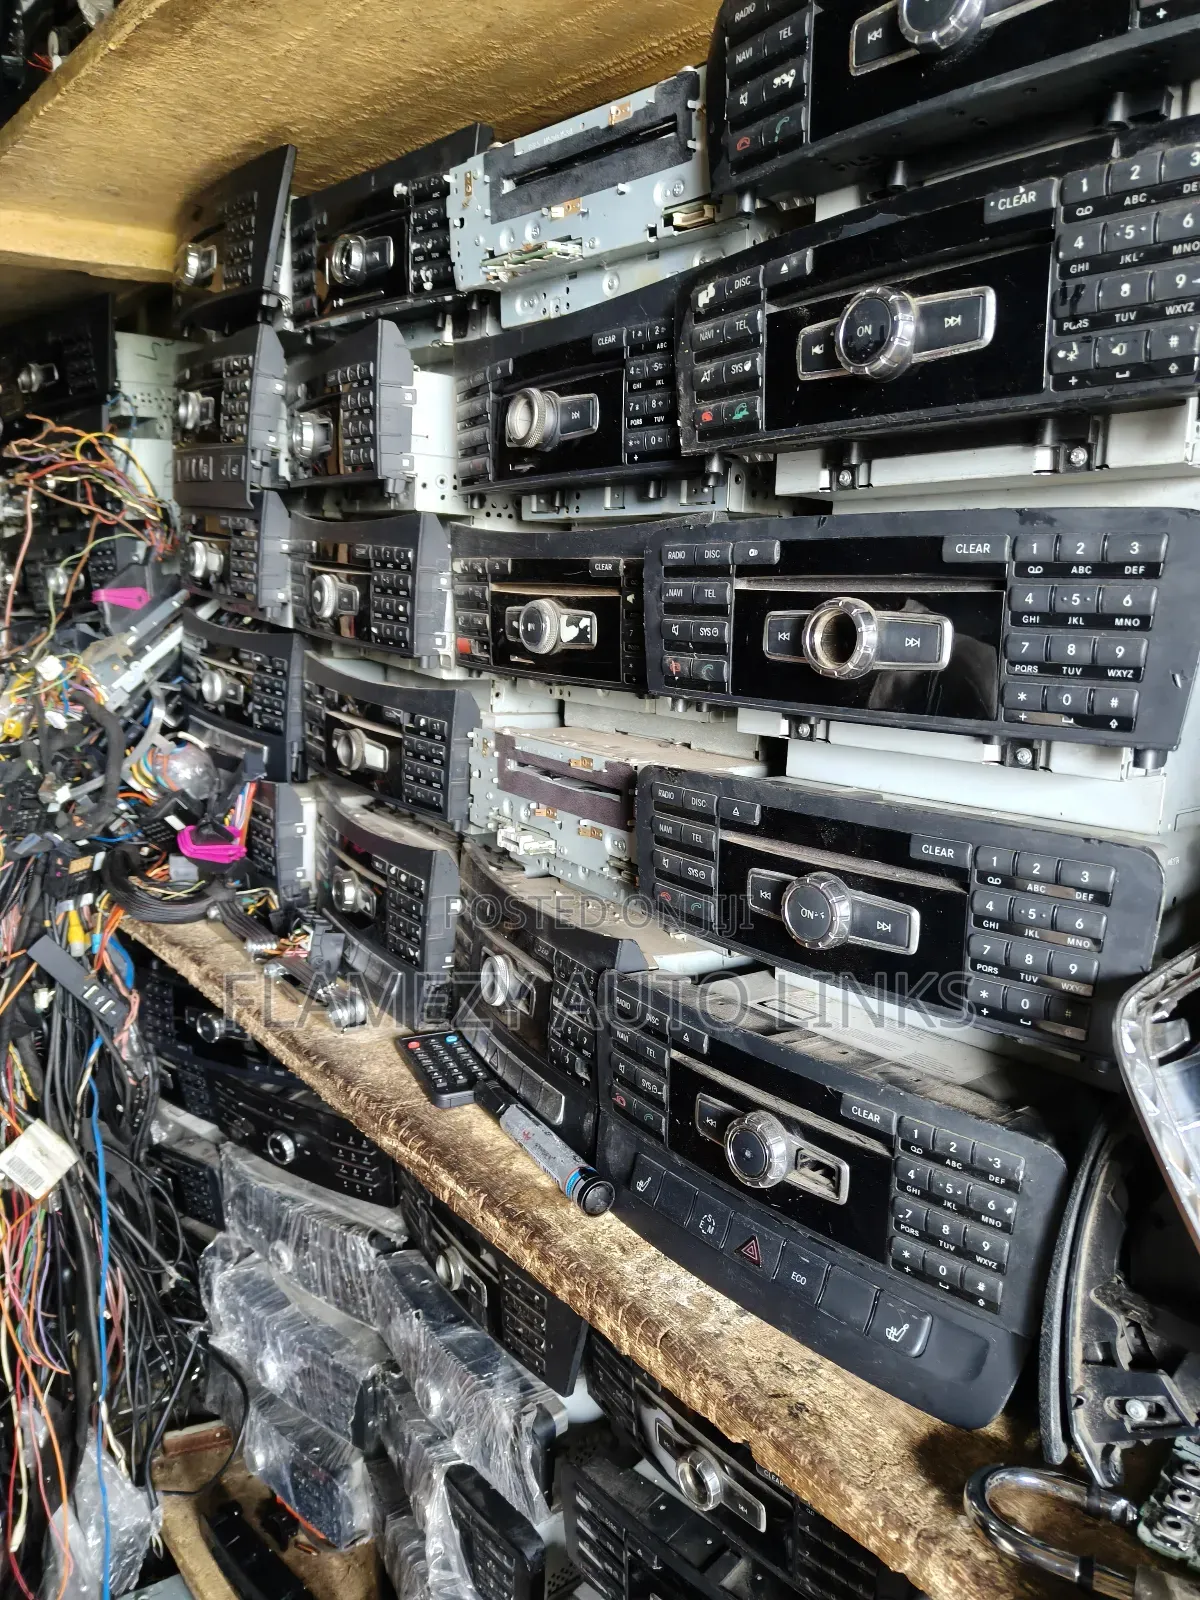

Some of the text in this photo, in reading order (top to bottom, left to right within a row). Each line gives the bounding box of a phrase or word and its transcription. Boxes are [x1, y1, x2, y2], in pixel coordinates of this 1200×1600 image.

[734, 2, 756, 22] RADIO
[779, 26, 792, 40] TEL
[736, 46, 752, 64] NAVI
[1081, 151, 1200, 192] 1 2 3
[998, 190, 1036, 210] CLEAR
[1124, 182, 1200, 206] ABC DE
[1074, 212, 1194, 249] 4 5 6
[1070, 241, 1200, 274] GHI JKL MNO
[734, 276, 751, 290] DISC
[1120, 274, 1186, 297] 8 9
[1114, 311, 1137, 322] TUV
[1165, 302, 1195, 315] WXYZ
[700, 321, 747, 341] NAVI TEL
[856, 324, 872, 337] ON
[598, 334, 616, 346] CLEAR
[630, 366, 634, 375] 4
[731, 362, 743, 374] SYS
[630, 403, 634, 412] 7
[668, 550, 720, 560] RADIO DISC
[955, 542, 1140, 554] CLEAR 1 2 3
[594, 563, 612, 571] CLEAR
[1071, 565, 1145, 575] ABC DEF
[669, 589, 716, 598] NAVI TEL
[1025, 592, 1132, 606] 4 5 6
[1022, 615, 1140, 626] GHI JKL MNO
[700, 627, 711, 636] SYS
[1021, 642, 1125, 658] 7 8 9
[1015, 665, 1134, 678] PQRS TUV WXYZ
[1062, 694, 1072, 706] 0
[658, 789, 706, 808] RADIO DISC
[659, 824, 703, 843] NAVI TEL
[687, 867, 698, 877] SYS
[922, 844, 1089, 883] CLEAR 1 2 3
[1027, 884, 1094, 902] ABC DEF
[986, 900, 1084, 929] 4 5 6
[983, 920, 1090, 948] GHI JKL MNO
[983, 945, 1078, 975] 7 8 9
[976, 963, 998, 975] PQRS
[1019, 972, 1039, 983] TUV
[616, 996, 659, 1026] RADIO DISC
[1021, 998, 1030, 1010] 0
[616, 1031, 656, 1058] NAVI TEL
[642, 1079, 651, 1091] SYS
[851, 1106, 1001, 1168] CLEAR 1 2 3
[945, 1159, 1006, 1185] ABC DEF
[908, 1169, 996, 1210] 4 5 6
[906, 1185, 1002, 1228] GHI JKL MNO
[708, 1226, 714, 1235] M
[906, 1209, 990, 1251] 7 8 9
[900, 1224, 998, 1269] PQRS TUV WXYZ
[791, 1271, 806, 1286] ECO
[939, 1265, 946, 1276] 0
